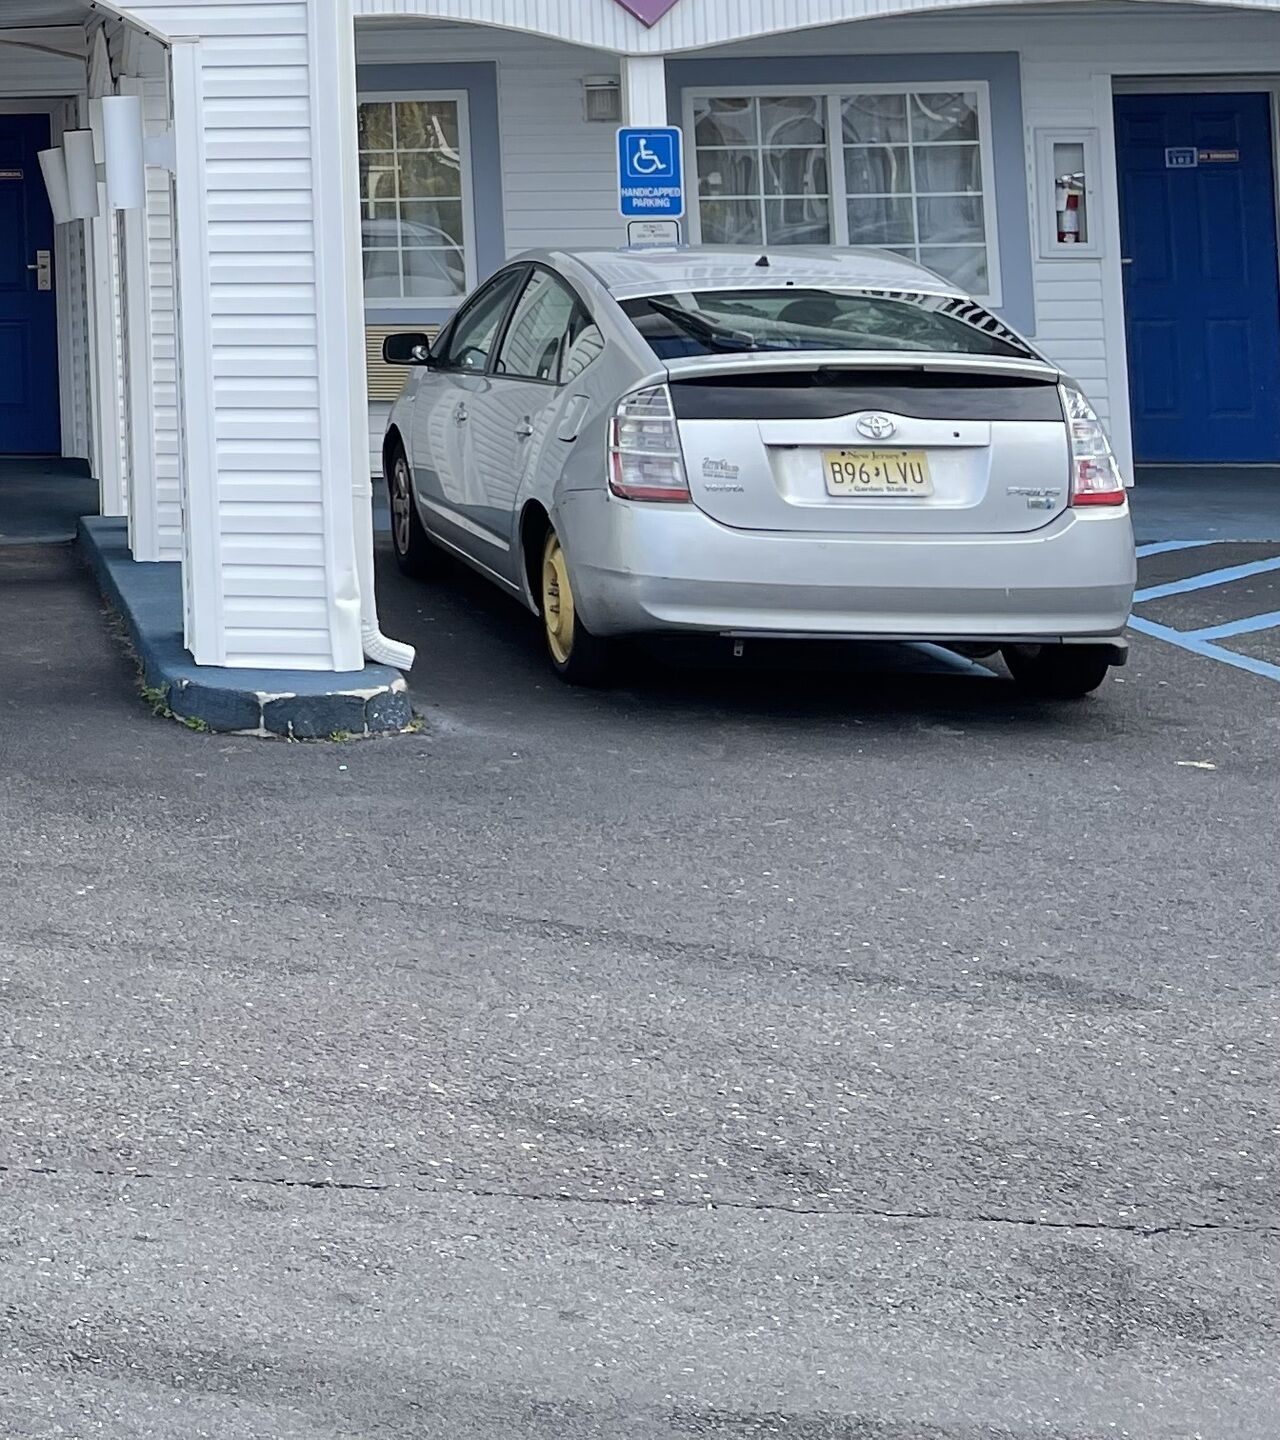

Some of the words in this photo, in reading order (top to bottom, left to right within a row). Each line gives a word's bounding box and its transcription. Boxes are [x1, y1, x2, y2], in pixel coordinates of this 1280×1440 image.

[621, 186, 681, 198] HANDICAPPED
[632, 197, 671, 208] PARKING
[872, 450, 900, 461] Jersey
